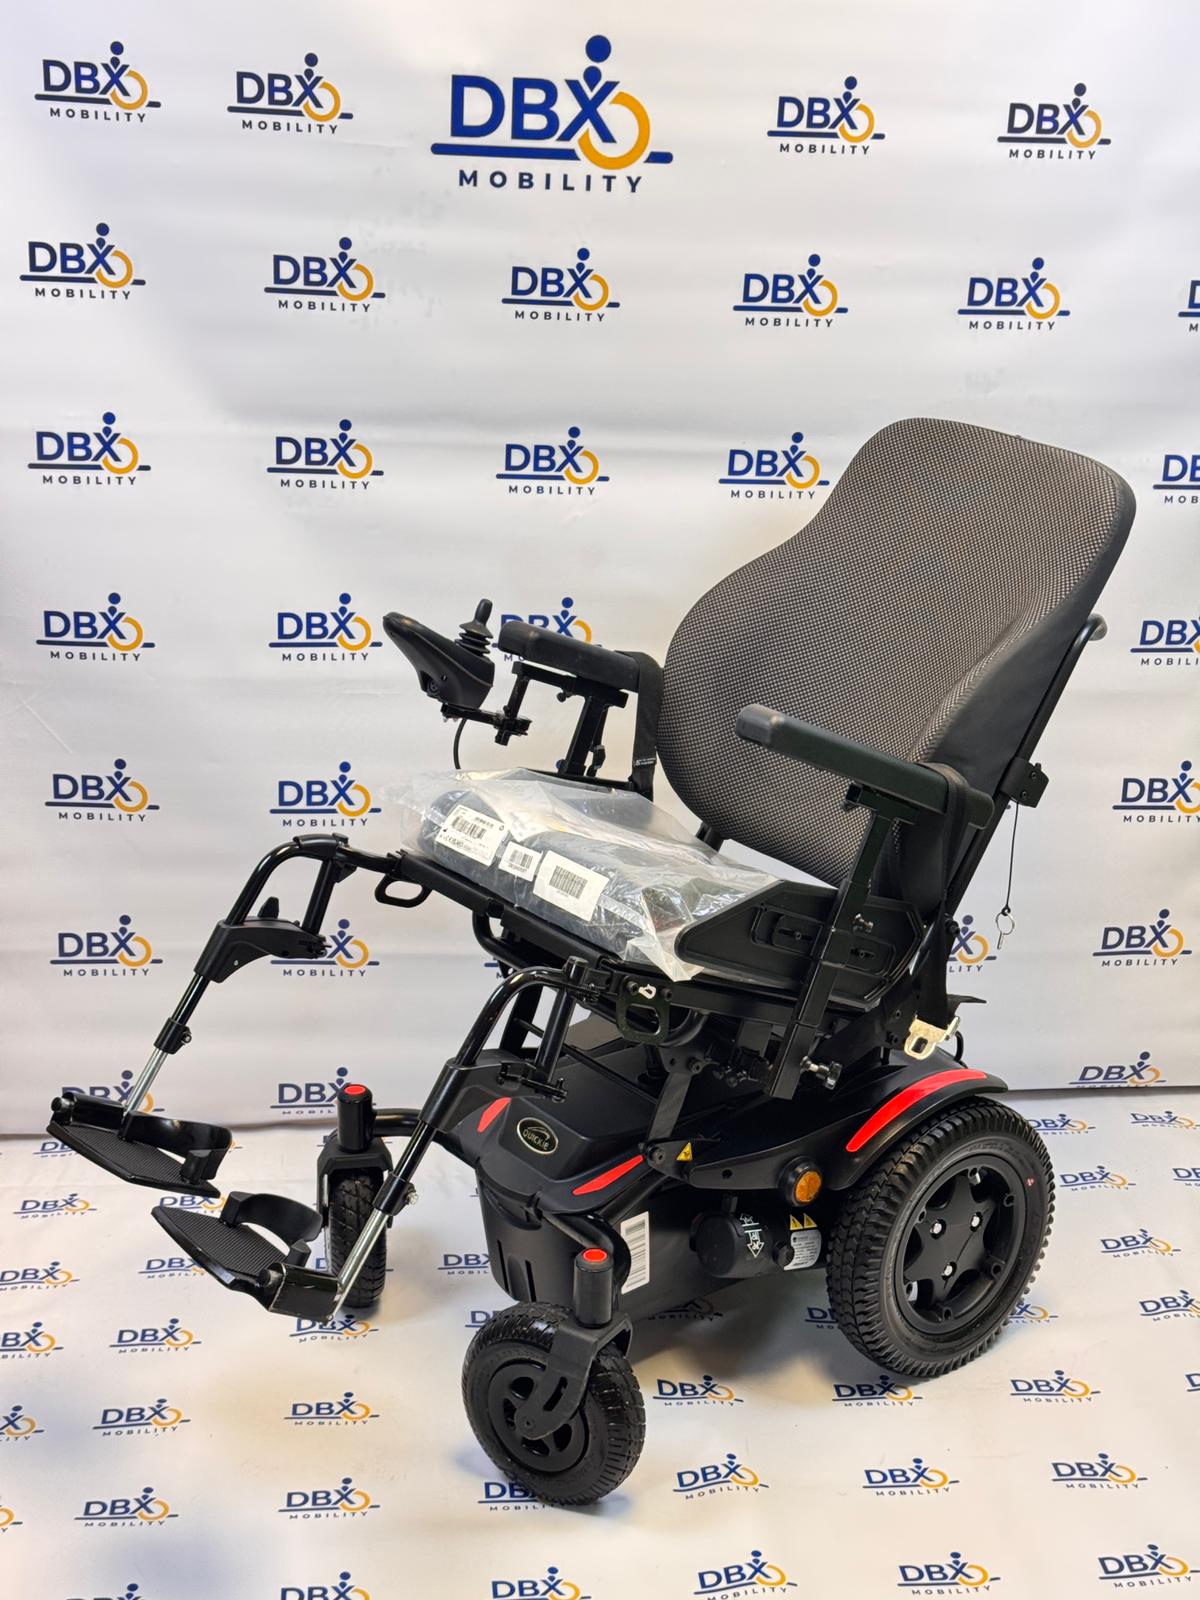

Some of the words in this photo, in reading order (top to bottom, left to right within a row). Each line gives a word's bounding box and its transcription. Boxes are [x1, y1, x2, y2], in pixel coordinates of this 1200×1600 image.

[50, 107, 146, 123] MOBILITY
[242, 120, 338, 134] MOBILITY
[780, 143, 869, 155] MOBILITY
[1009, 149, 1096, 160] MOBILITY
[459, 169, 642, 193] MOBILITY
[35, 288, 130, 300] MOBILITY
[278, 300, 370, 312] MOBILITY
[515, 310, 605, 322] MOBILITY
[745, 317, 833, 327] MOBILITY
[969, 321, 1055, 330] MOBILITY
[43, 475, 136, 485] MOBILITY
[280, 479, 369, 490] MOBILITY
[509, 485, 595, 495] MOBILITY
[731, 490, 815, 499] MOBILITY
[50, 651, 140, 661] MOBILITY
[282, 653, 368, 661] MOBILITY
[59, 812, 146, 822] MOBILITY
[282, 818, 367, 827] MOBILITY
[1102, 959, 1178, 967] MOBILITY
[64, 968, 149, 976] MOBILITY
[283, 969, 366, 977] MOBILITY
[103, 1427, 177, 1436] MOBILITY
[685, 1486, 758, 1499] MOBILITY
[876, 1488, 949, 1496] MOBILITY
[290, 1511, 367, 1519] MOBILITY
[1114, 1576, 1191, 1587] MOBILITY
[912, 1585, 989, 1594] MOBILITY
